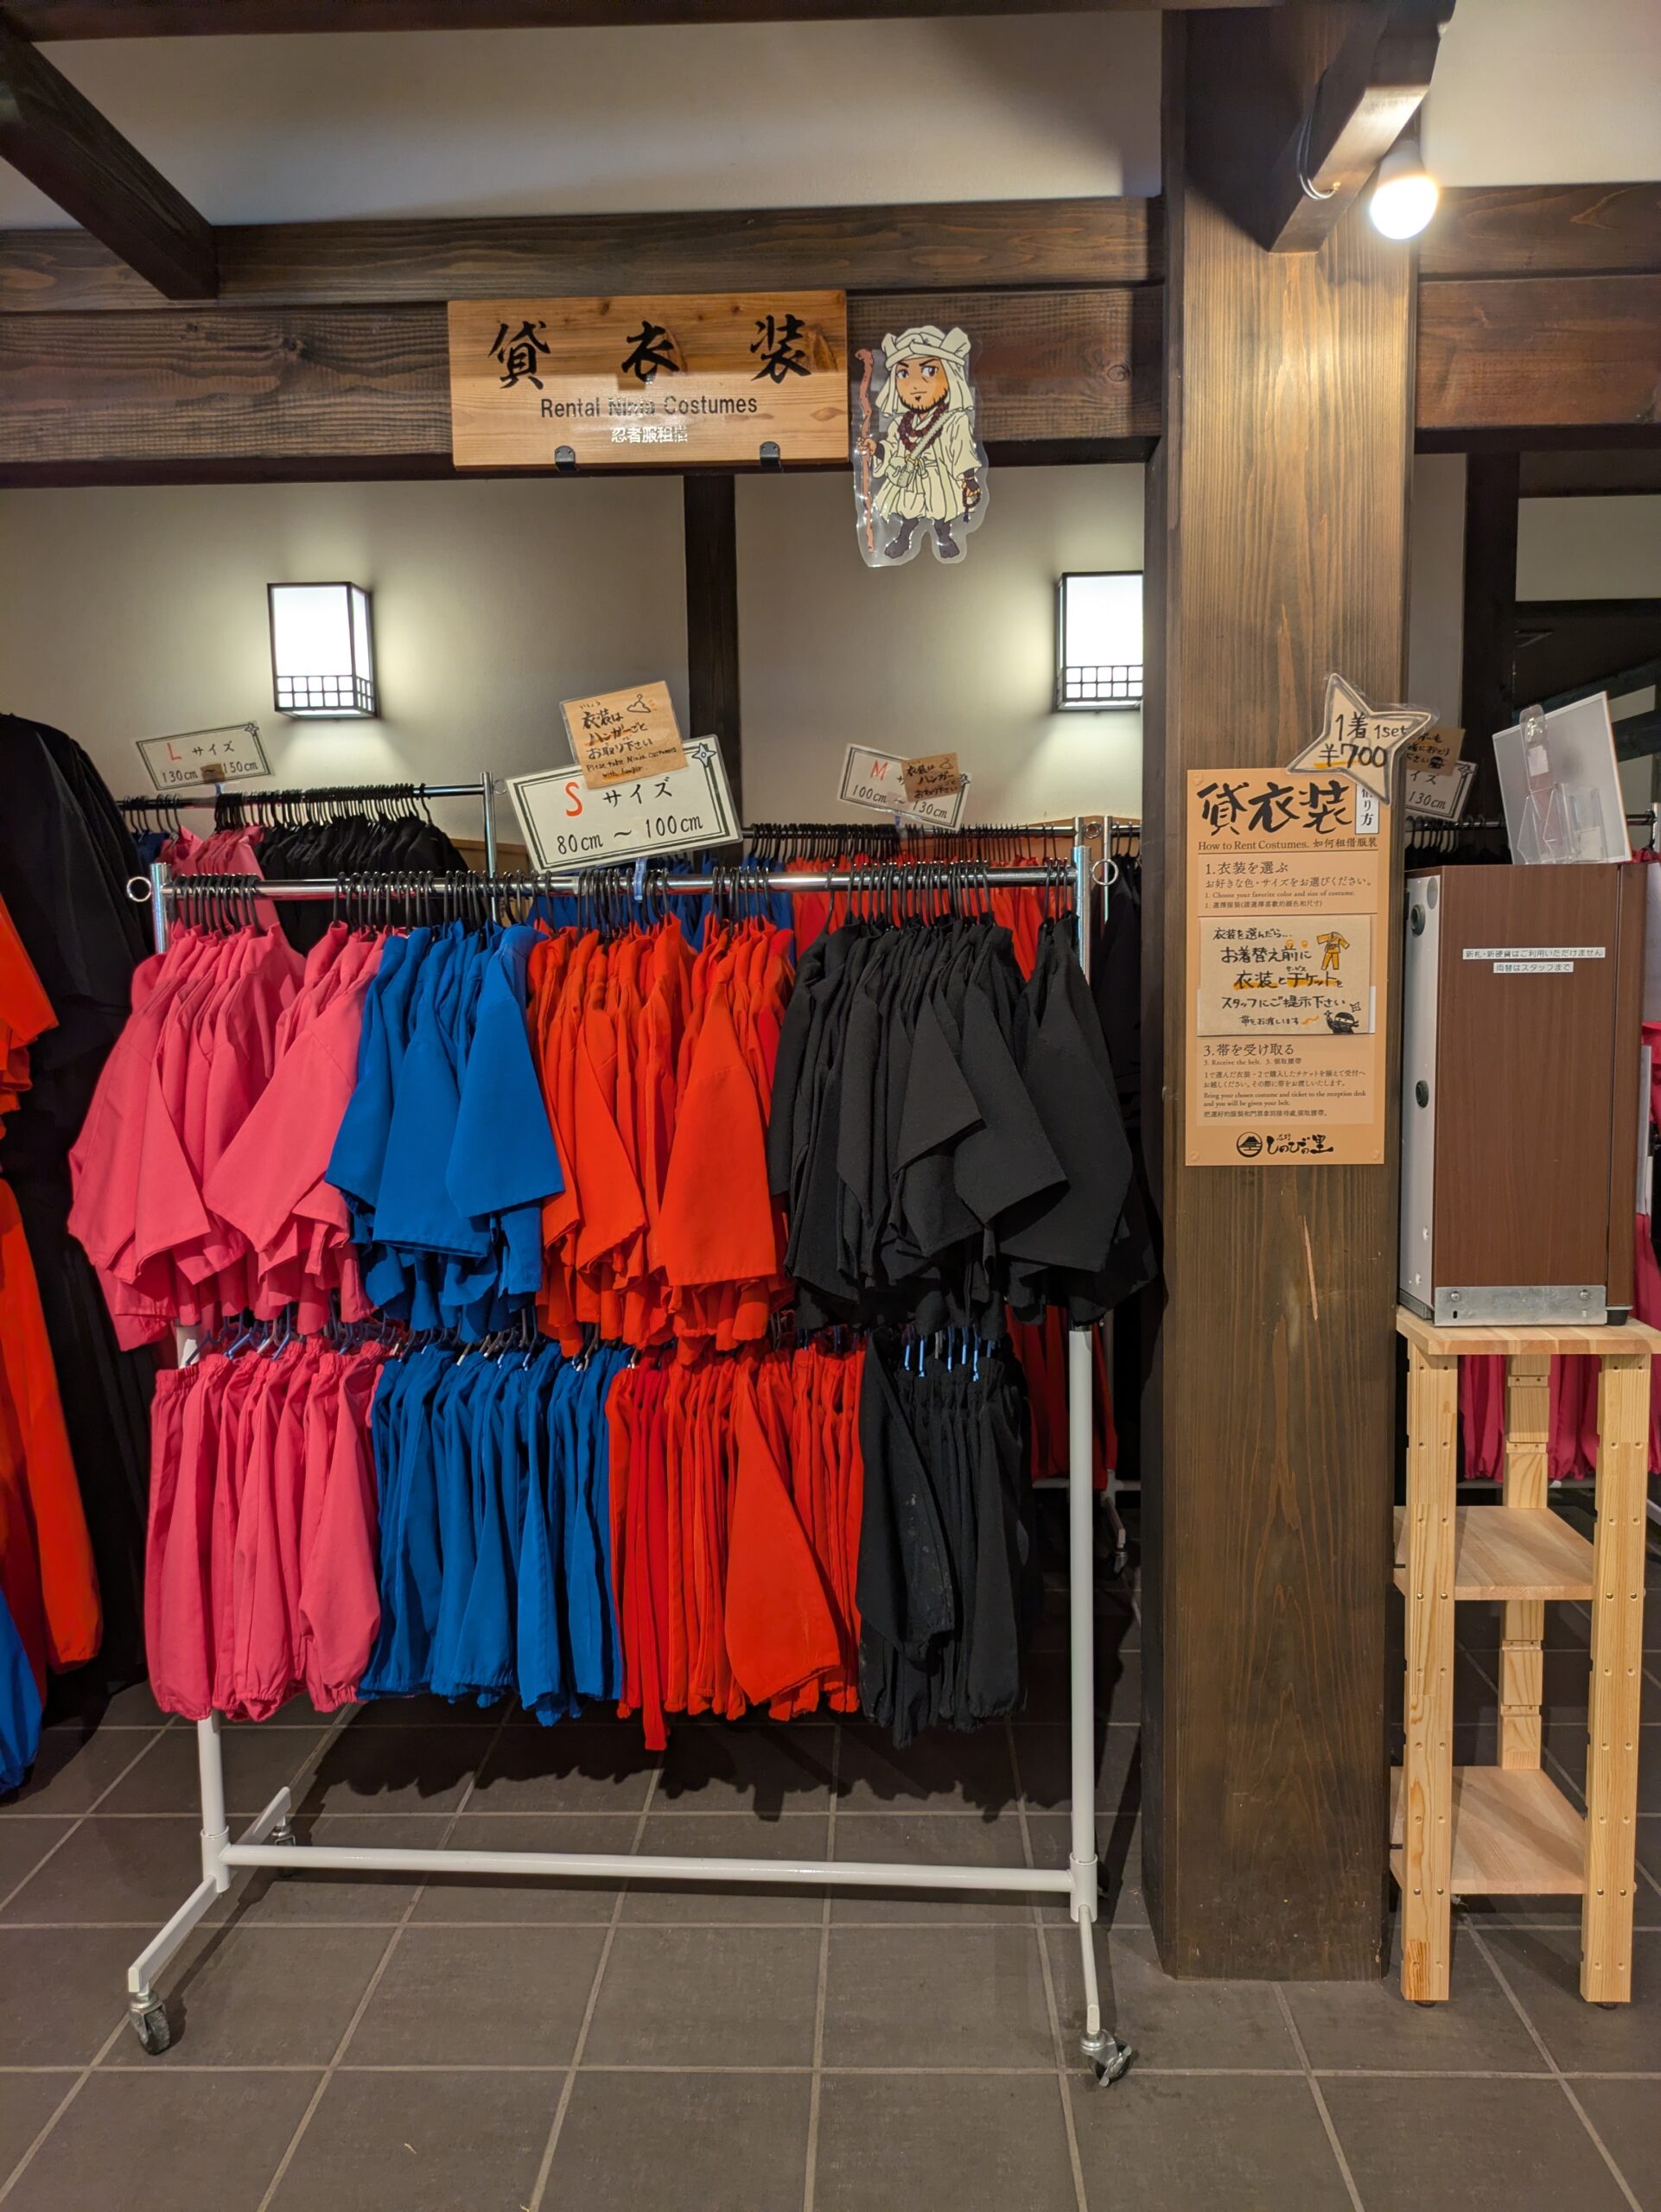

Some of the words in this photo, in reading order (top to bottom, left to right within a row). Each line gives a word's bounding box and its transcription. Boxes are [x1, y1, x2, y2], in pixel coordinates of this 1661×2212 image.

[487, 314, 811, 390] 貸衣装
[541, 397, 600, 417] Rental
[608, 397, 656, 418] Ninja
[664, 396, 758, 416] Costumes
[582, 709, 624, 729] 衣装は
[1335, 711, 1368, 741] 1着
[1373, 724, 1410, 740] 1set
[589, 721, 648, 746] ハンガーごと
[167, 742, 182, 761] L
[192, 740, 235, 757] サイズ
[586, 739, 653, 760] お取り下さい
[162, 769, 199, 784] 130cm
[223, 761, 258, 775] 150cm
[870, 760, 889, 782] M
[565, 781, 583, 817] S
[602, 776, 672, 808] サイズ
[852, 784, 888, 804] 100cm
[913, 800, 948, 819] 130cm
[1409, 791, 1446, 810] 130cm
[1196, 780, 1353, 836] 貸衣装
[557, 833, 603, 855] 80cm
[646, 815, 703, 840] 100cm
[1198, 841, 1220, 851] How
[1222, 842, 1232, 850] to
[1234, 841, 1257, 850] Rent
[1257, 839, 1310, 849] Costumes.
[1220, 945, 1313, 963] お着替え前に
[1236, 970, 1344, 989] 衣装とチケットを
[1221, 995, 1346, 1009] スタッフにご提示下さい
